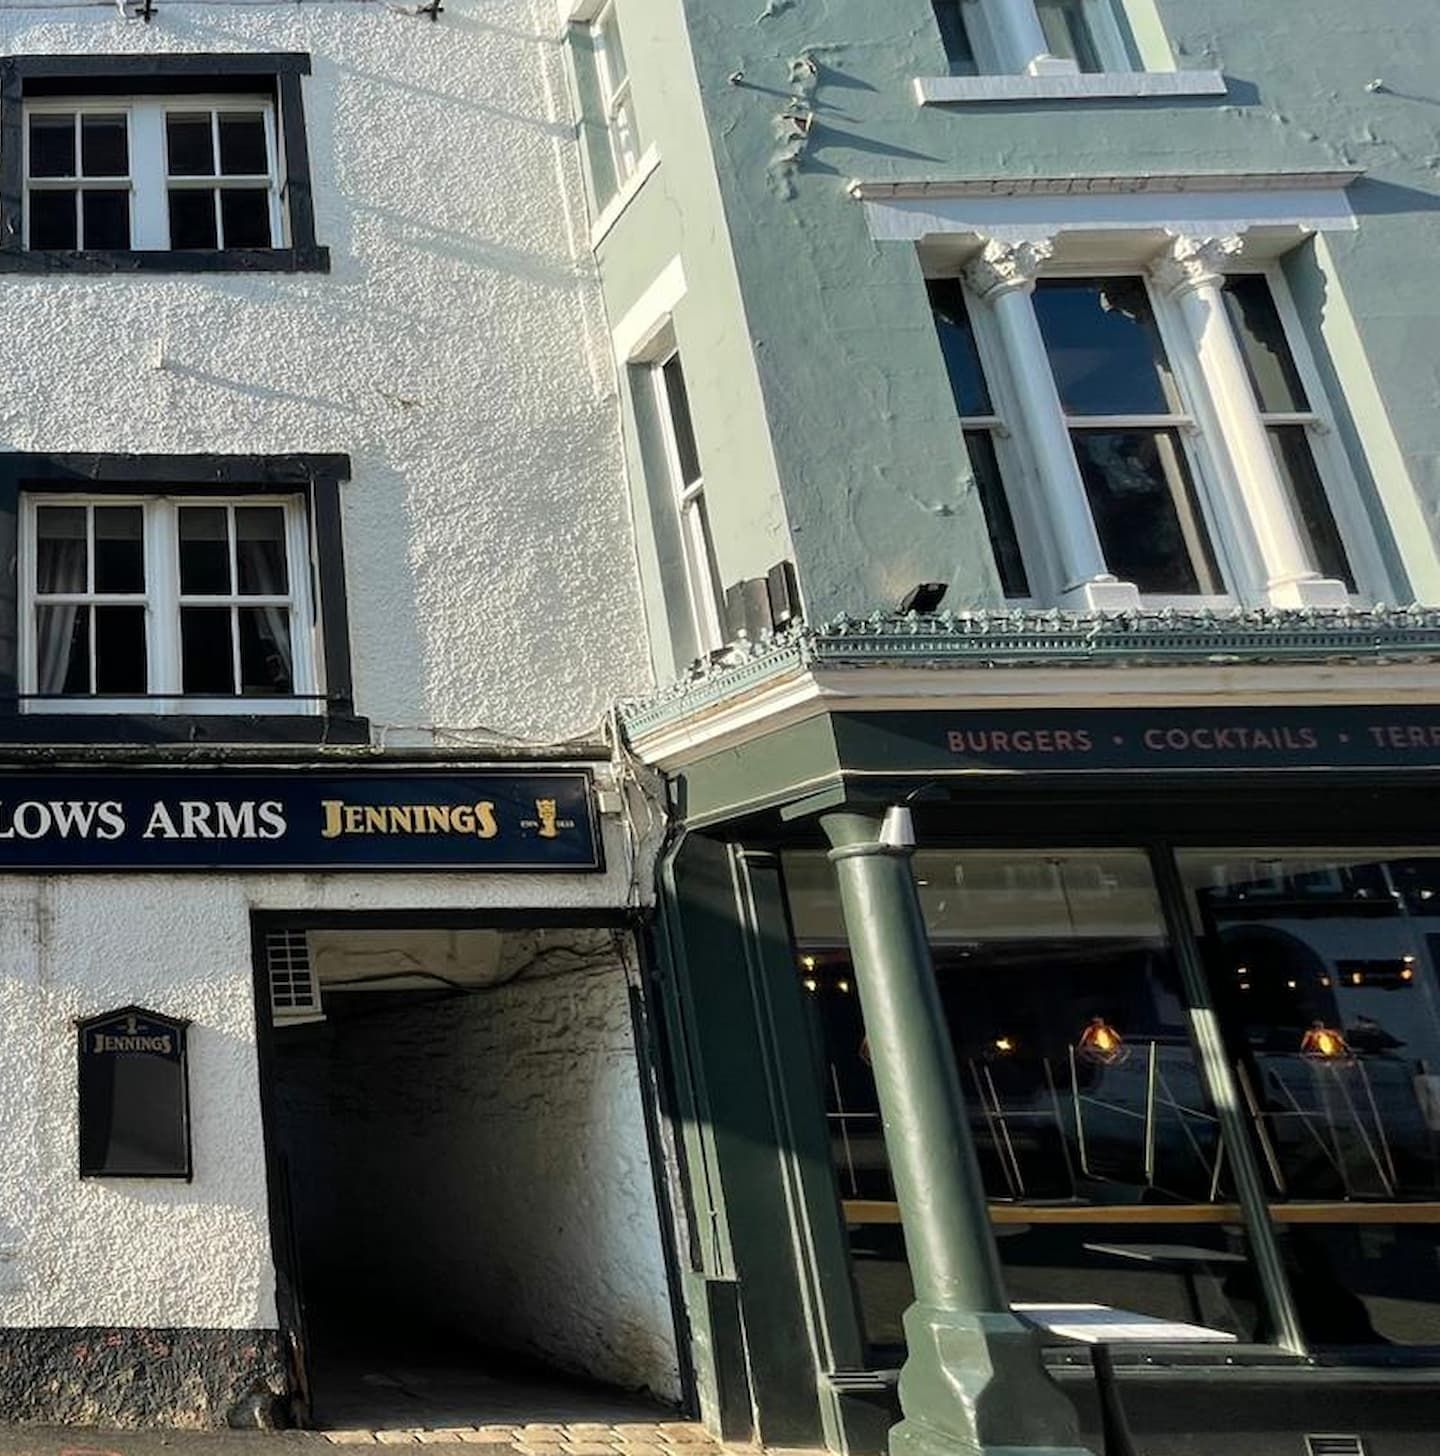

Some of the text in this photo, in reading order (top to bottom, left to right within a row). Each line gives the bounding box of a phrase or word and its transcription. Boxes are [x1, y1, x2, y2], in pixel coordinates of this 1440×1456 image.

[946, 729, 1093, 753] BURGERS
[1143, 727, 1319, 750] COCKTAILS
[142, 800, 287, 839] ARMS
[320, 800, 498, 839] JENNINGS
[92, 1033, 172, 1054] JENNINGS
